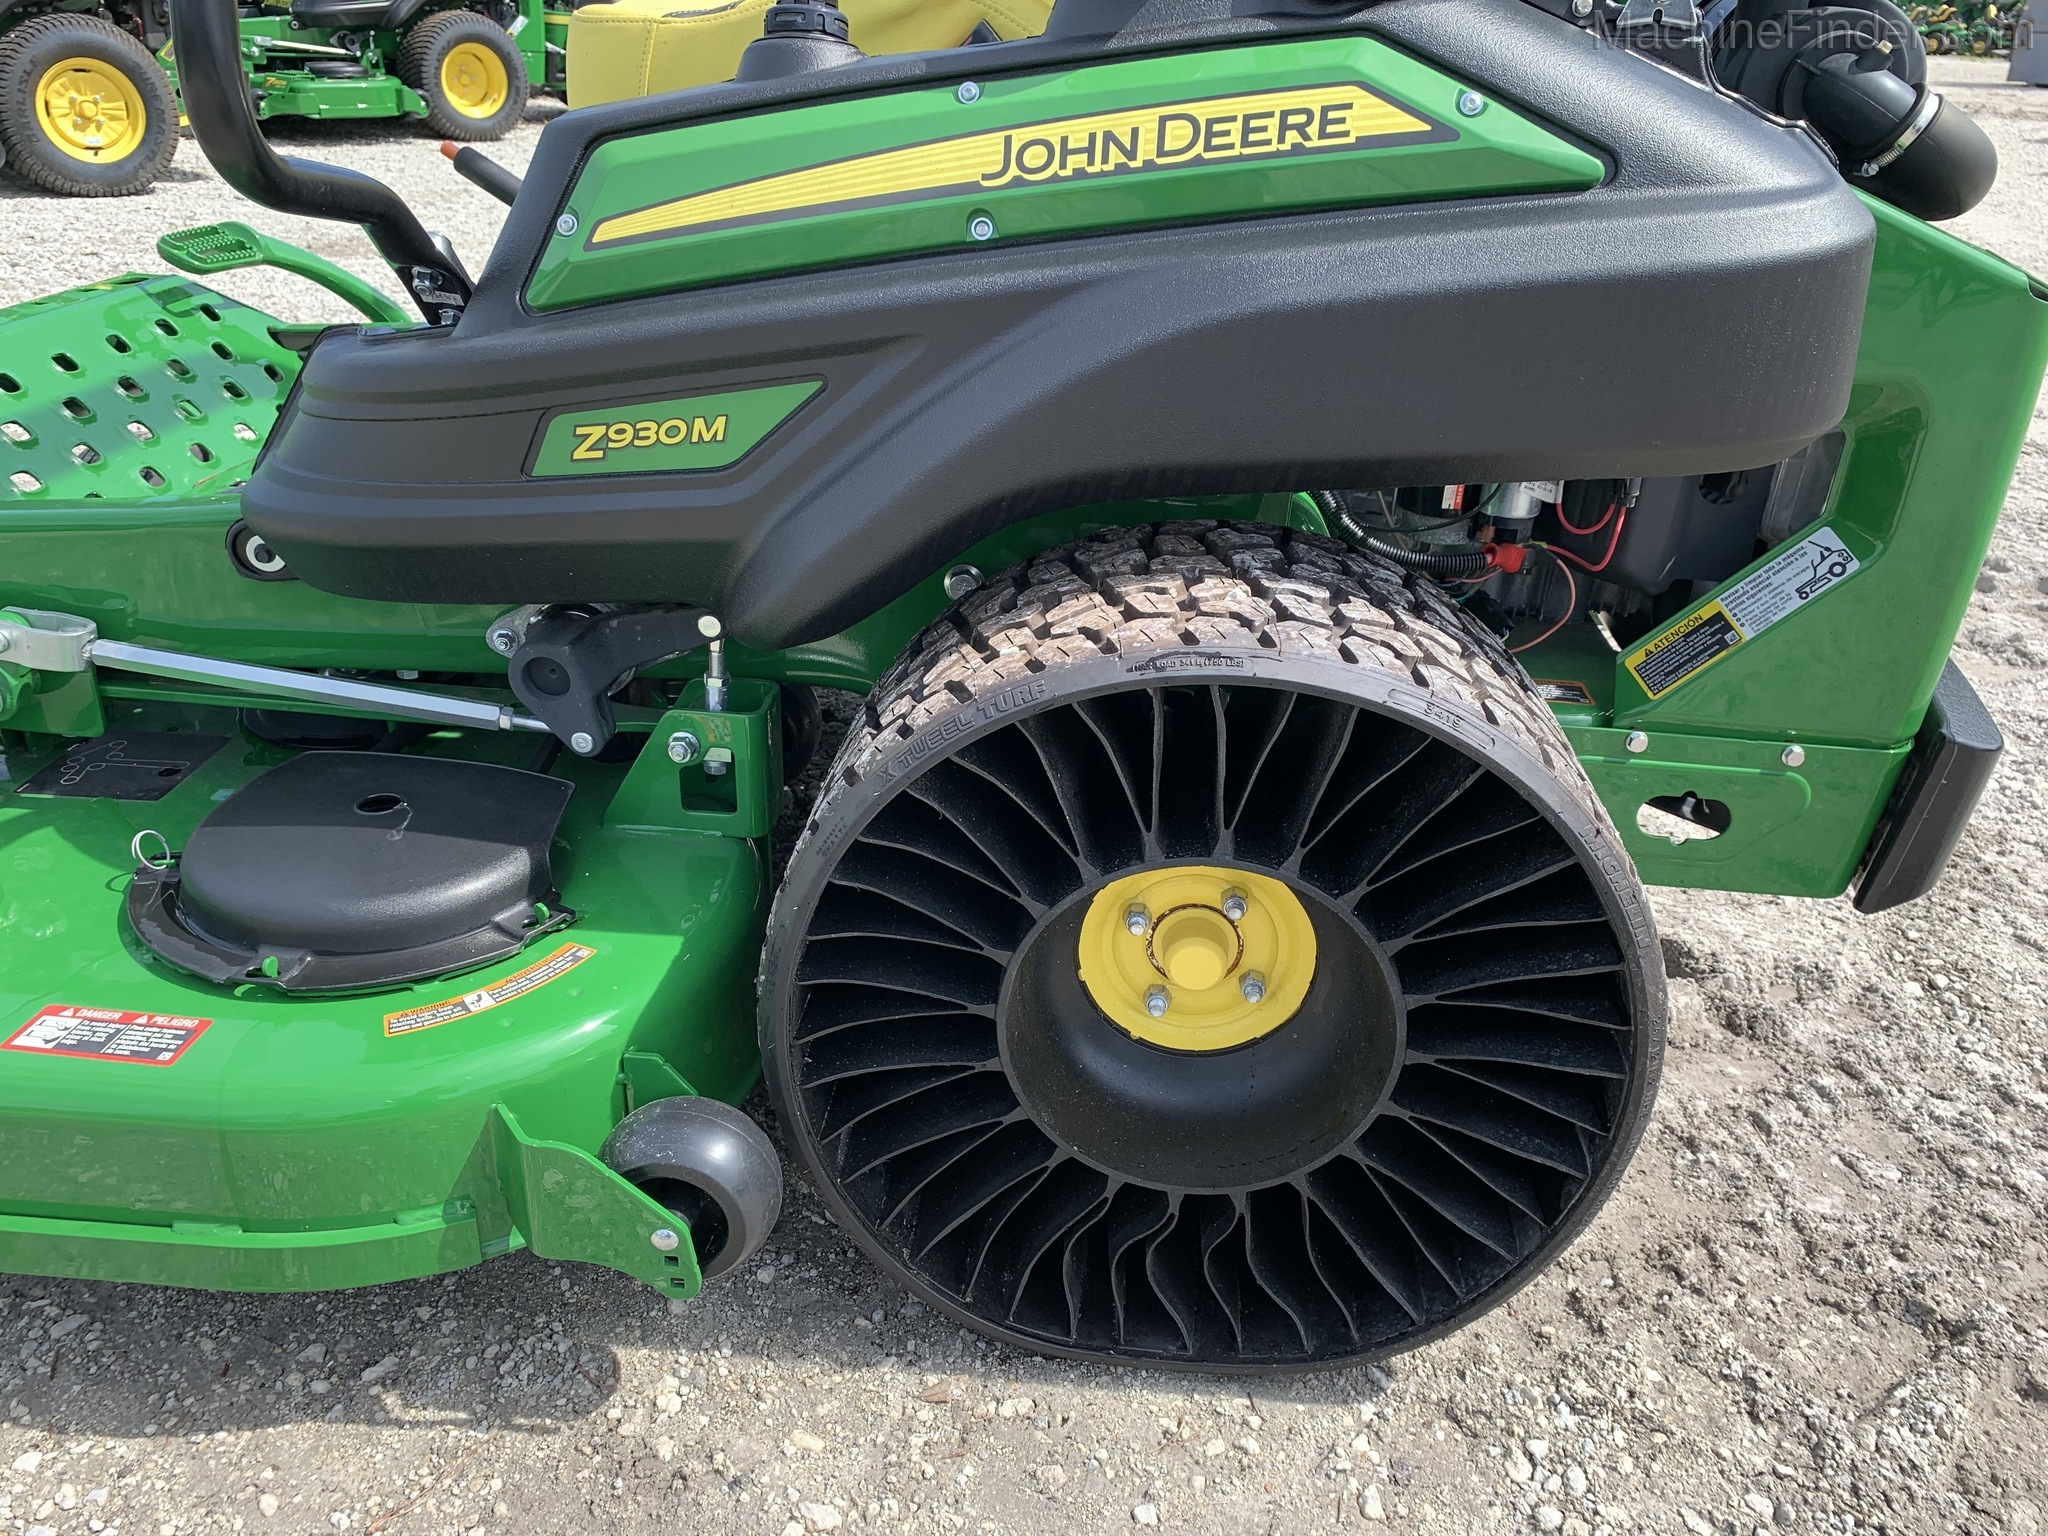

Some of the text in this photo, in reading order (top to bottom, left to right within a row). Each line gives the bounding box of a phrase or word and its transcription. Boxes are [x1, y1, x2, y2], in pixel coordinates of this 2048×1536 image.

[980, 102, 1356, 187] JOHN DEERE
[571, 414, 728, 461] Z930M
[1654, 614, 1703, 651] ATENCIÓN
[1155, 659, 1177, 669] LOAD
[876, 679, 1047, 786] X TWEEL TURF
[1423, 703, 1464, 728] 3419
[1578, 824, 1651, 949] MICHELIN
[75, 1008, 122, 1020] DANGER
[149, 1016, 200, 1028] PELIGRO
